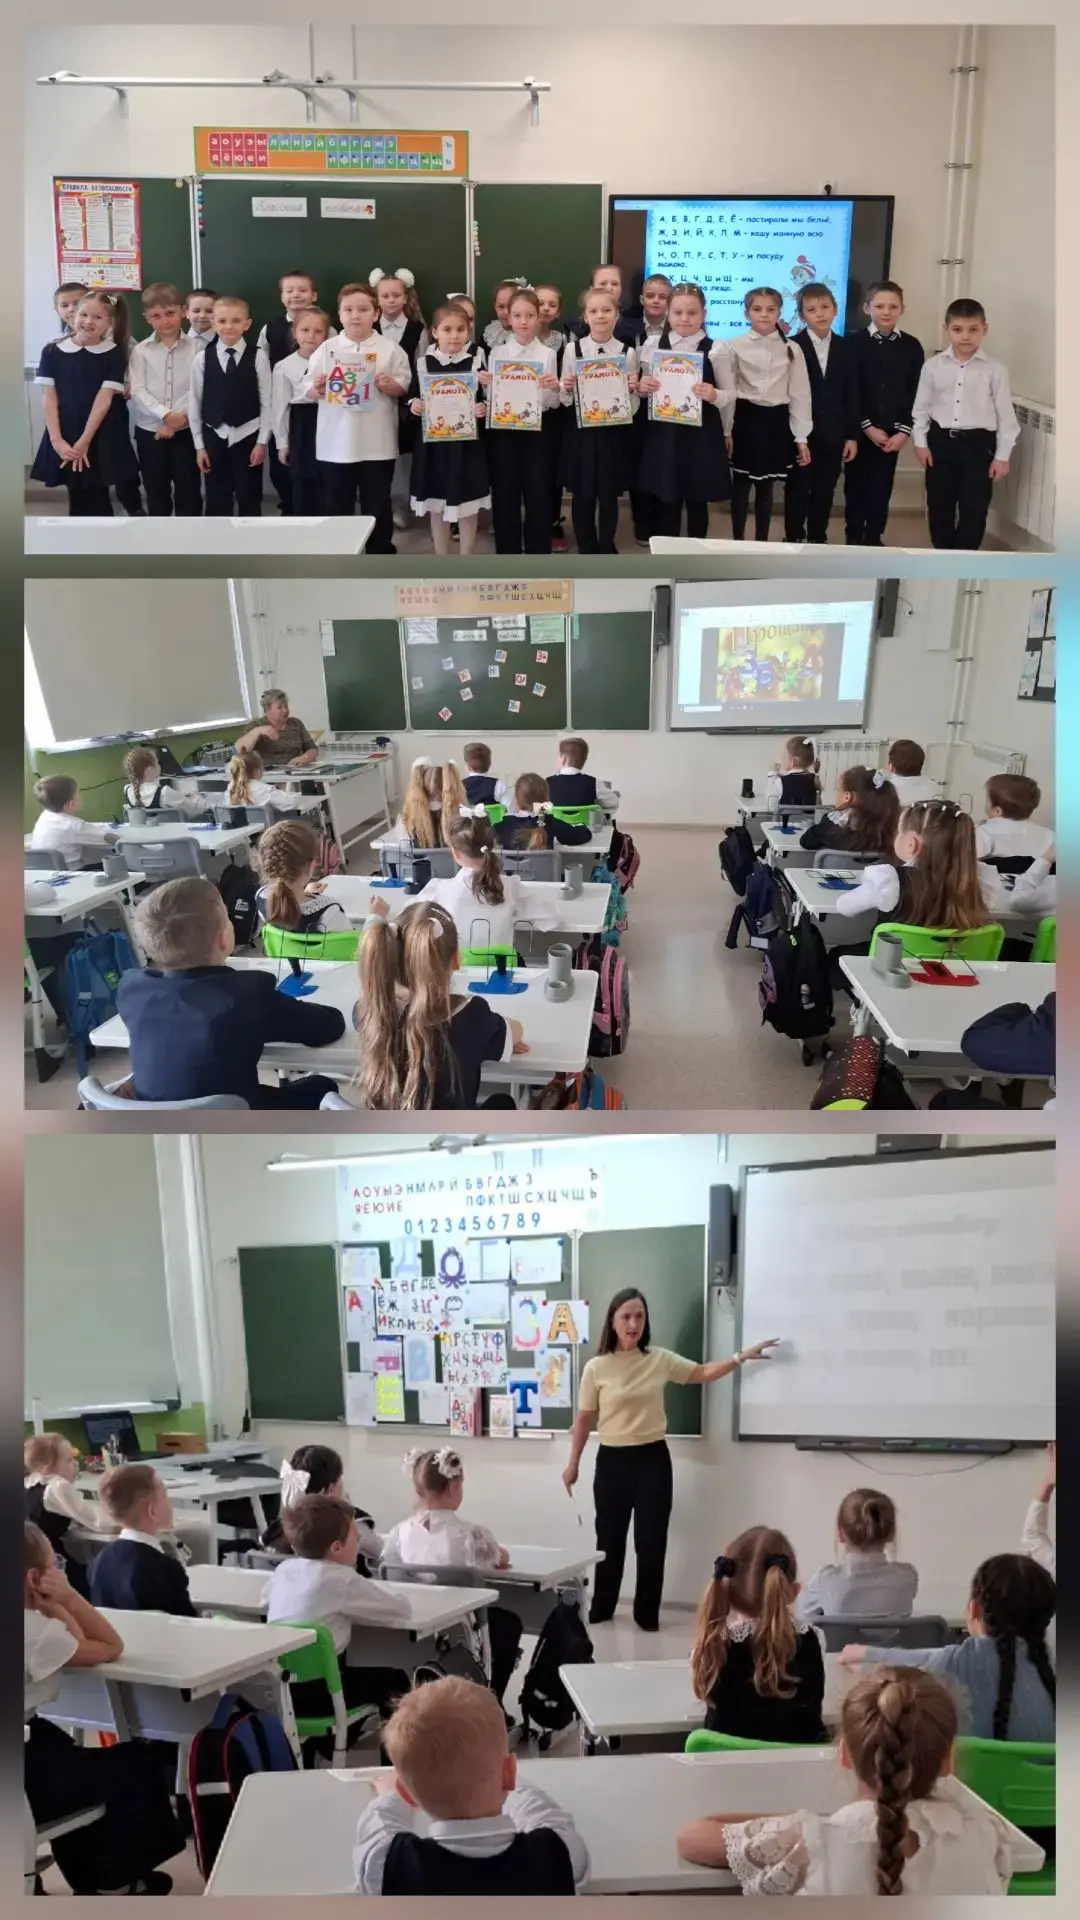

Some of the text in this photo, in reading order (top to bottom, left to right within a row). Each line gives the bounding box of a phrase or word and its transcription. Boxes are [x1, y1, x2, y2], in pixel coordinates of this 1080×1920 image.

[746, 217, 788, 225] постирали
[756, 254, 784, 262] посуду
[584, 371, 620, 379] ГРАМОТА
[431, 388, 468, 396] ГРАМОТА
